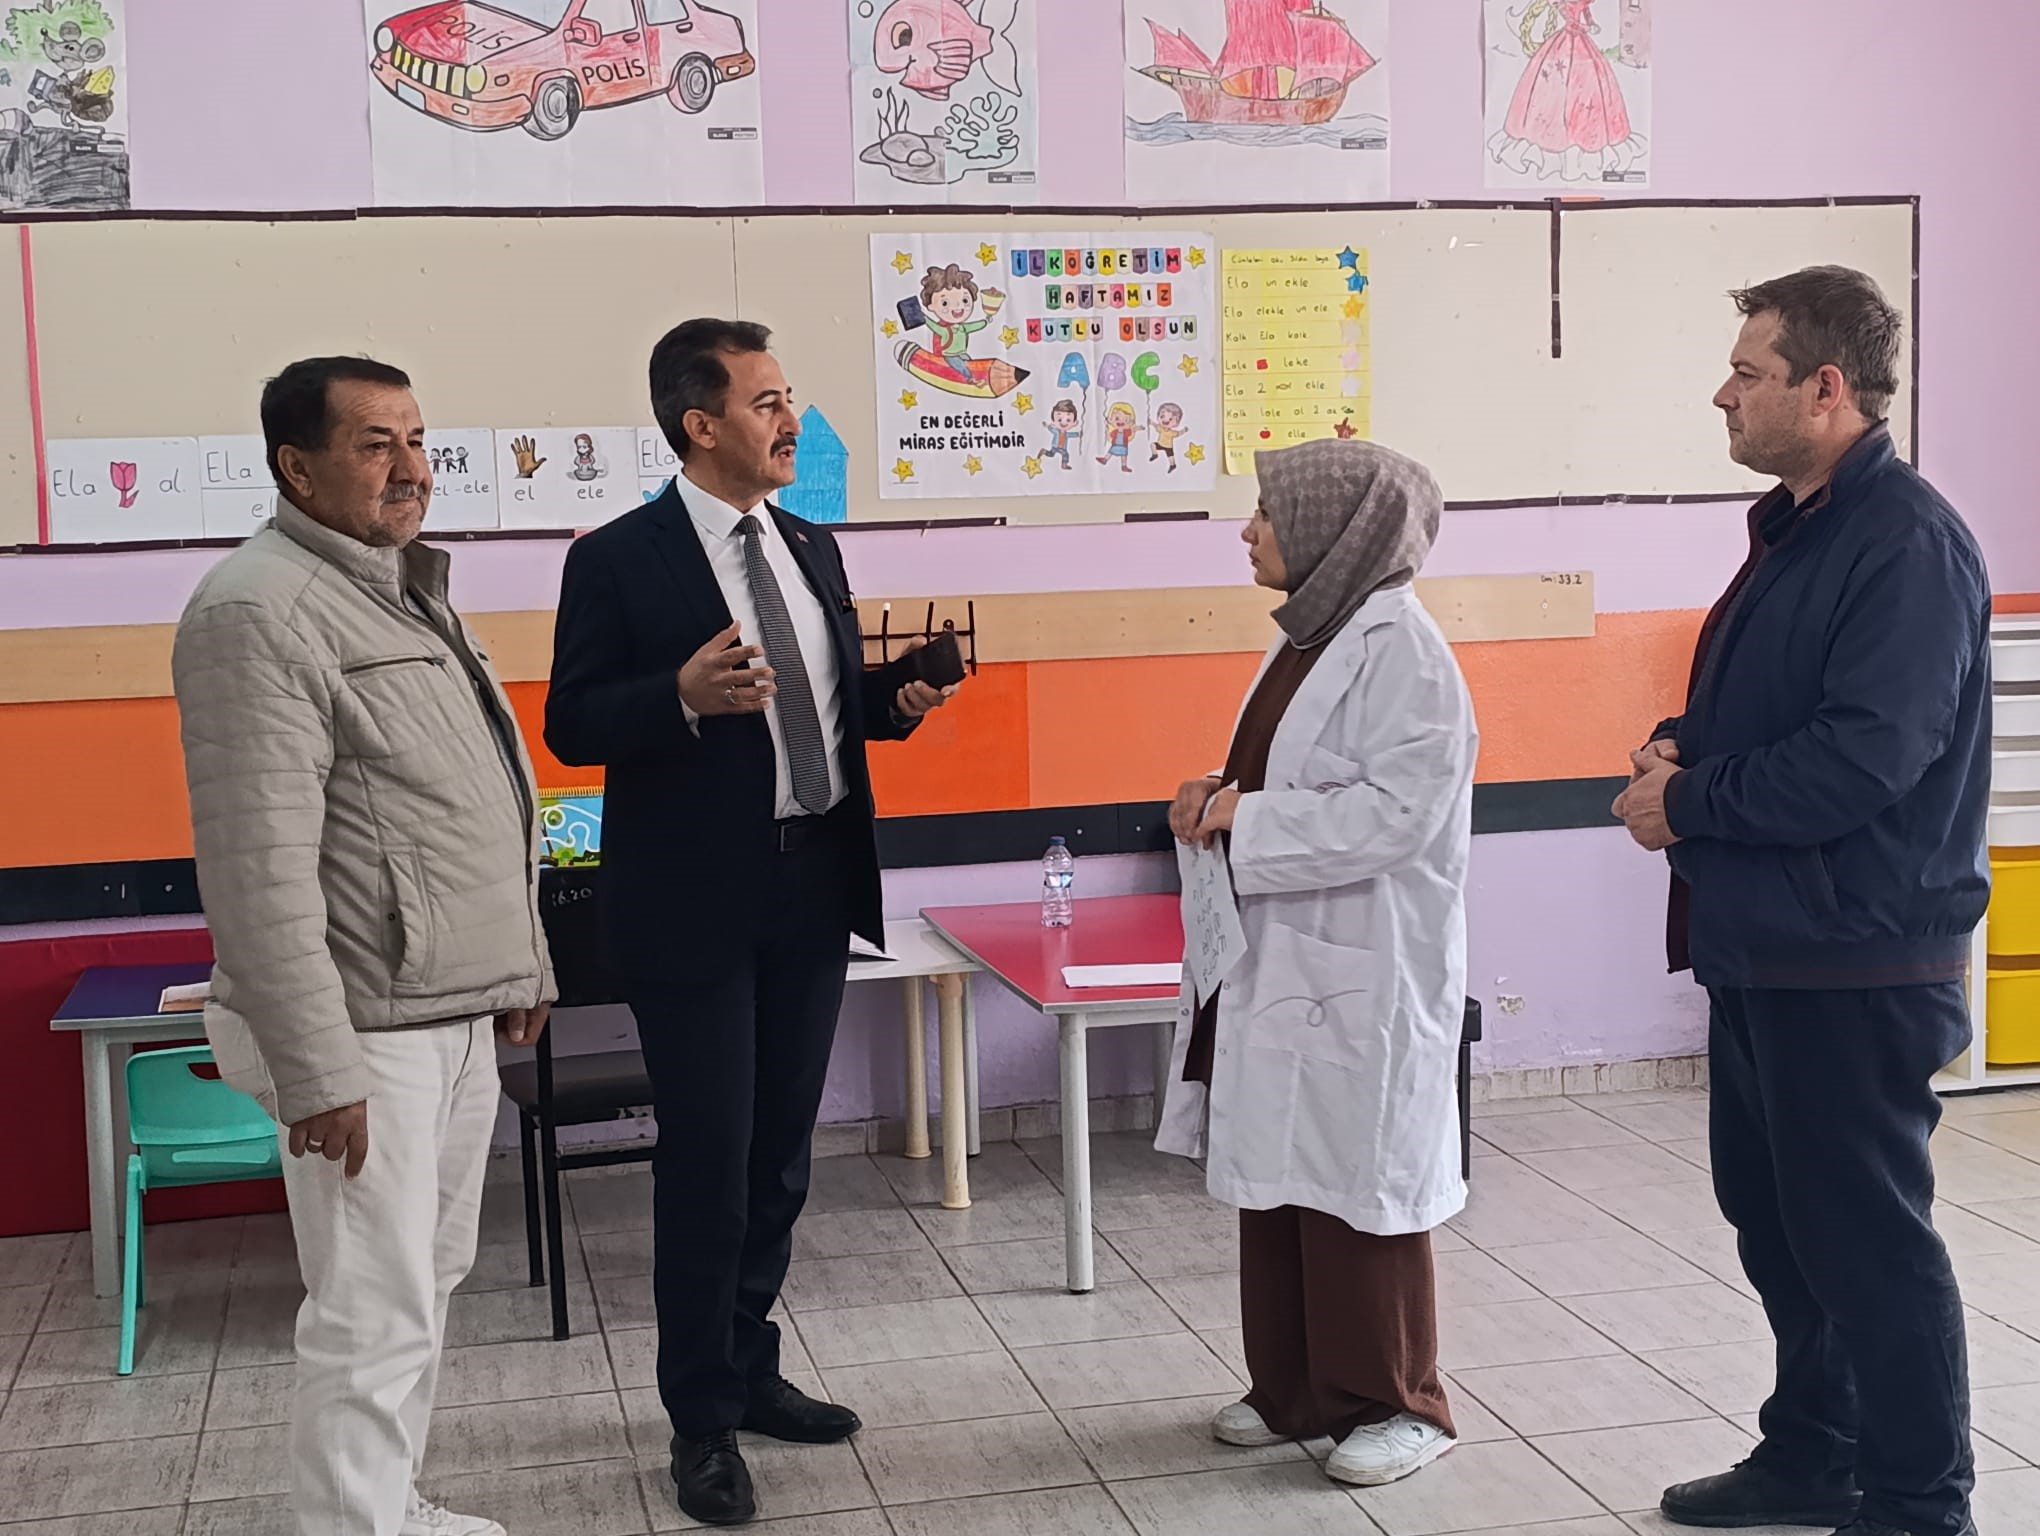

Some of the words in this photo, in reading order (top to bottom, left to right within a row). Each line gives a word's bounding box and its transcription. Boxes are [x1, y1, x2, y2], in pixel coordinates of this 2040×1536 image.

[438, 15, 514, 50] POLİS
[581, 56, 645, 86] POLİS
[1049, 289, 1169, 304] HAFTAMIZ
[1028, 322, 1101, 337] KUTLU
[1122, 321, 1195, 336] OLSUN
[1257, 382, 1267, 394] 2
[920, 415, 939, 429] EN
[944, 410, 1004, 429] DEĞERLİ
[899, 432, 945, 450] MİRAS
[950, 430, 1026, 450] EĞİTİMDİR
[641, 439, 676, 469] Ela
[206, 450, 252, 483] Ela
[52, 468, 97, 497] Ela
[514, 485, 536, 501] el
[576, 484, 605, 499] ele
